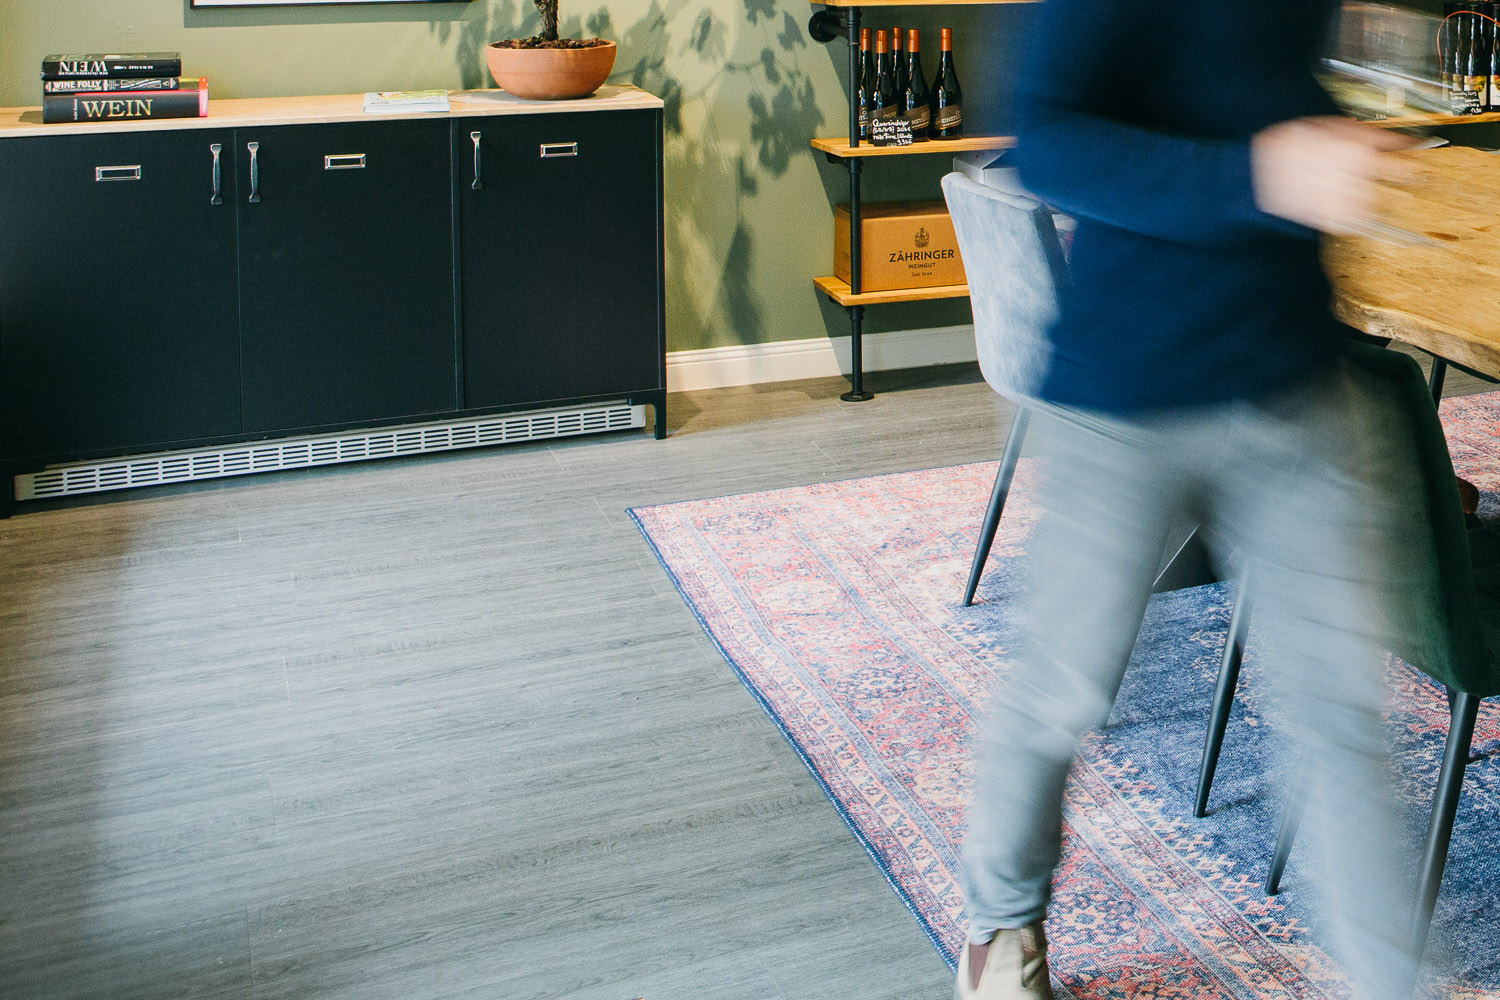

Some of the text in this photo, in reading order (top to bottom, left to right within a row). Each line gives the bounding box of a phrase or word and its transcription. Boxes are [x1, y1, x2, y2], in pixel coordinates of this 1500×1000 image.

[59, 61, 108, 72] WEIN
[52, 80, 76, 89] WINE
[77, 80, 102, 88] FOLLY
[82, 99, 153, 118] WEIN
[889, 249, 955, 262] ZÄHRINGER
